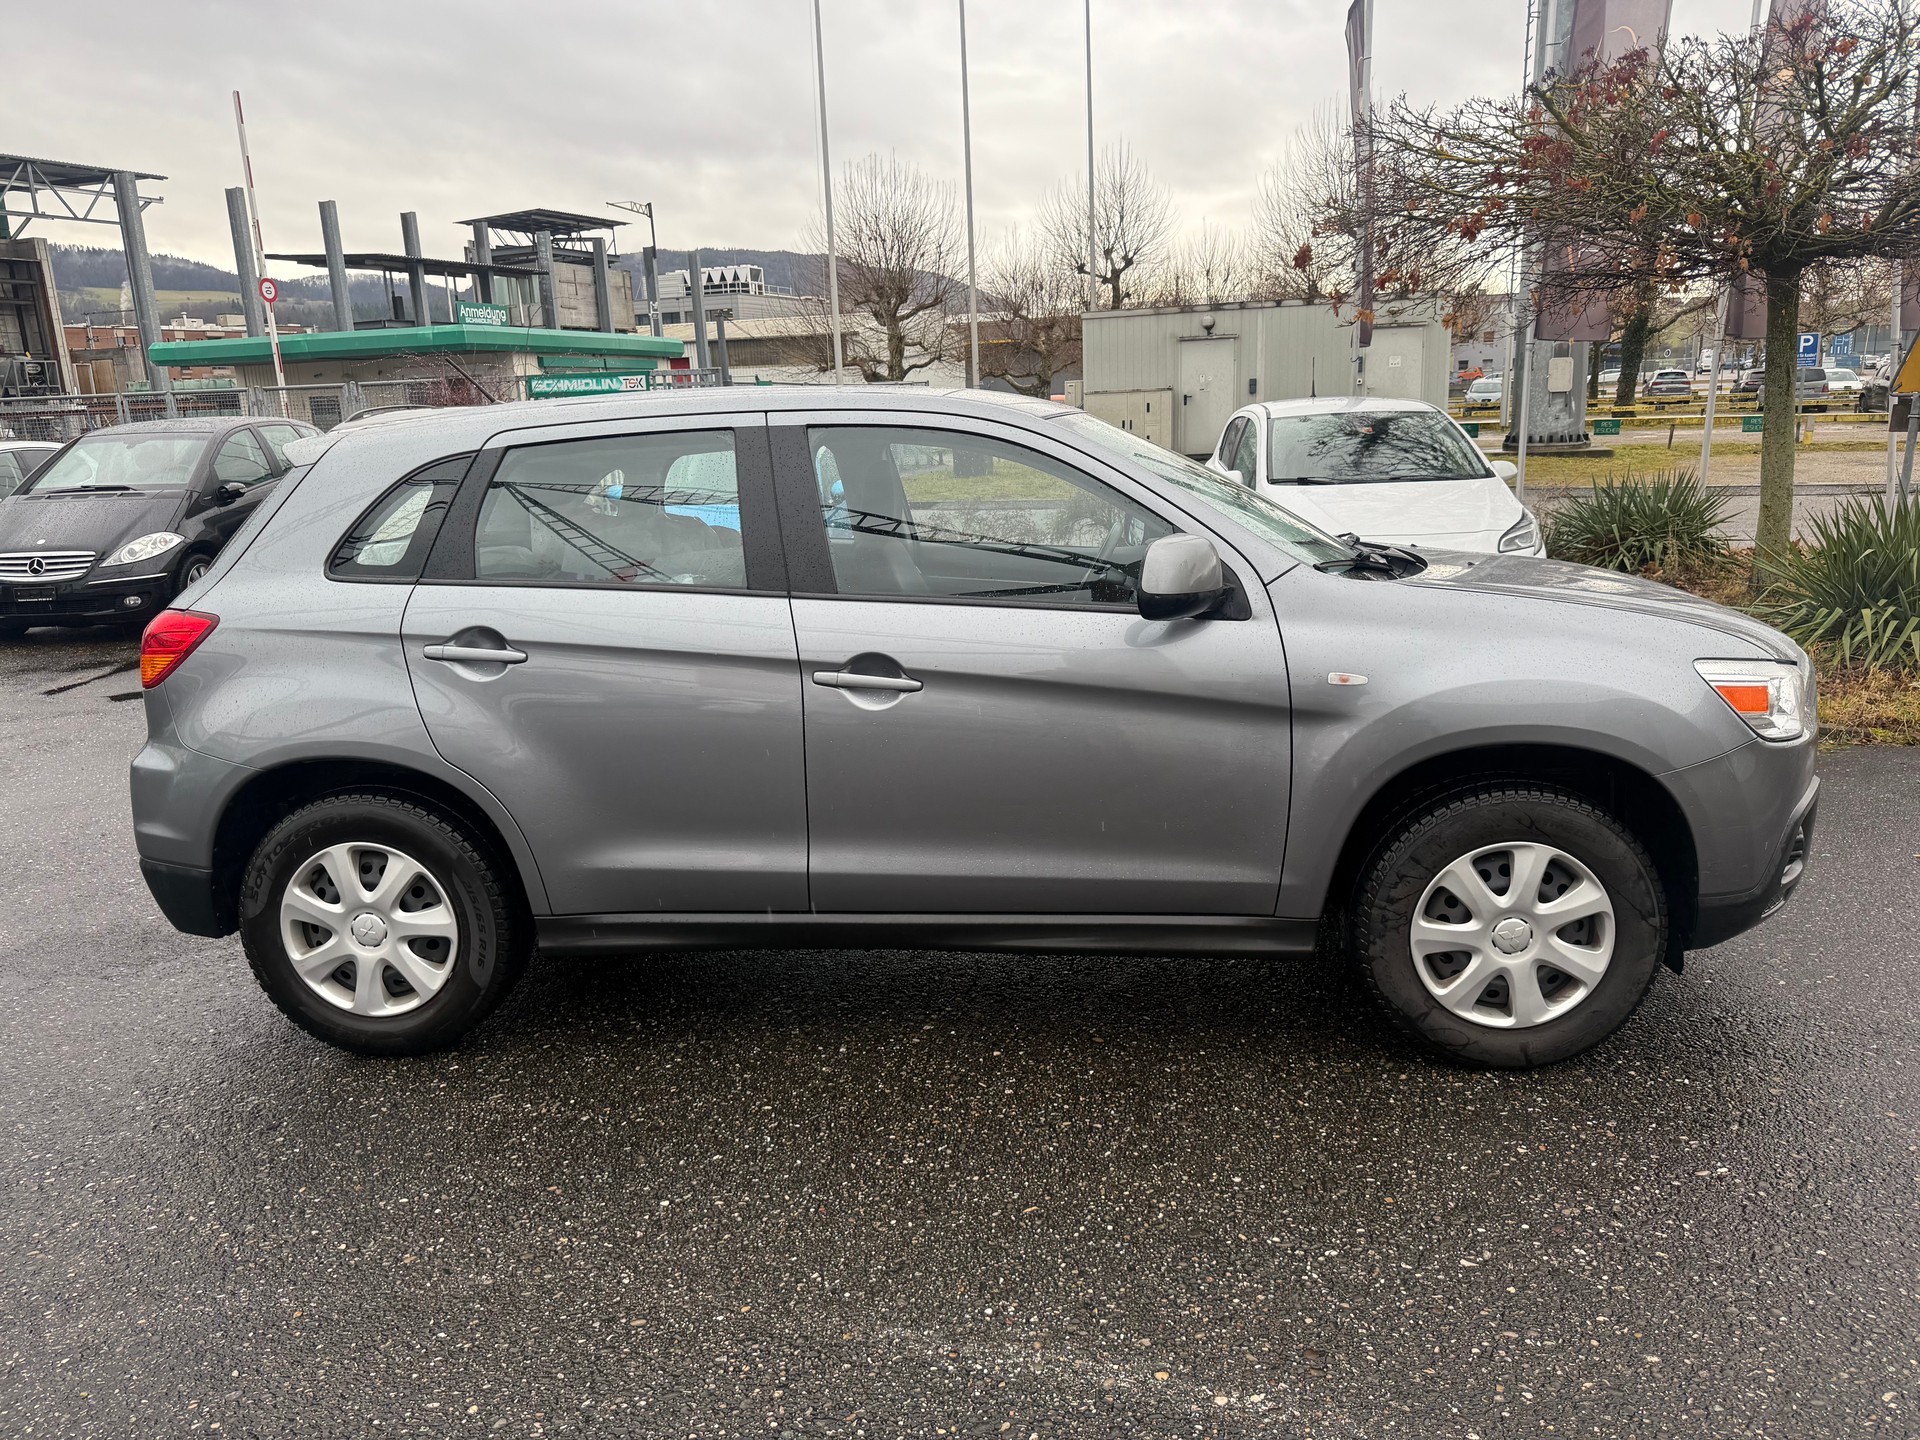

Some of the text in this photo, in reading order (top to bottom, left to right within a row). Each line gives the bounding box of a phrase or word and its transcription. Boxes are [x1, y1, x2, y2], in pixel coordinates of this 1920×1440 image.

[460, 304, 507, 322] Anmeldung
[1799, 335, 1815, 353] P
[622, 377, 645, 390] TSK
[462, 880, 488, 969] 215/65 R16
